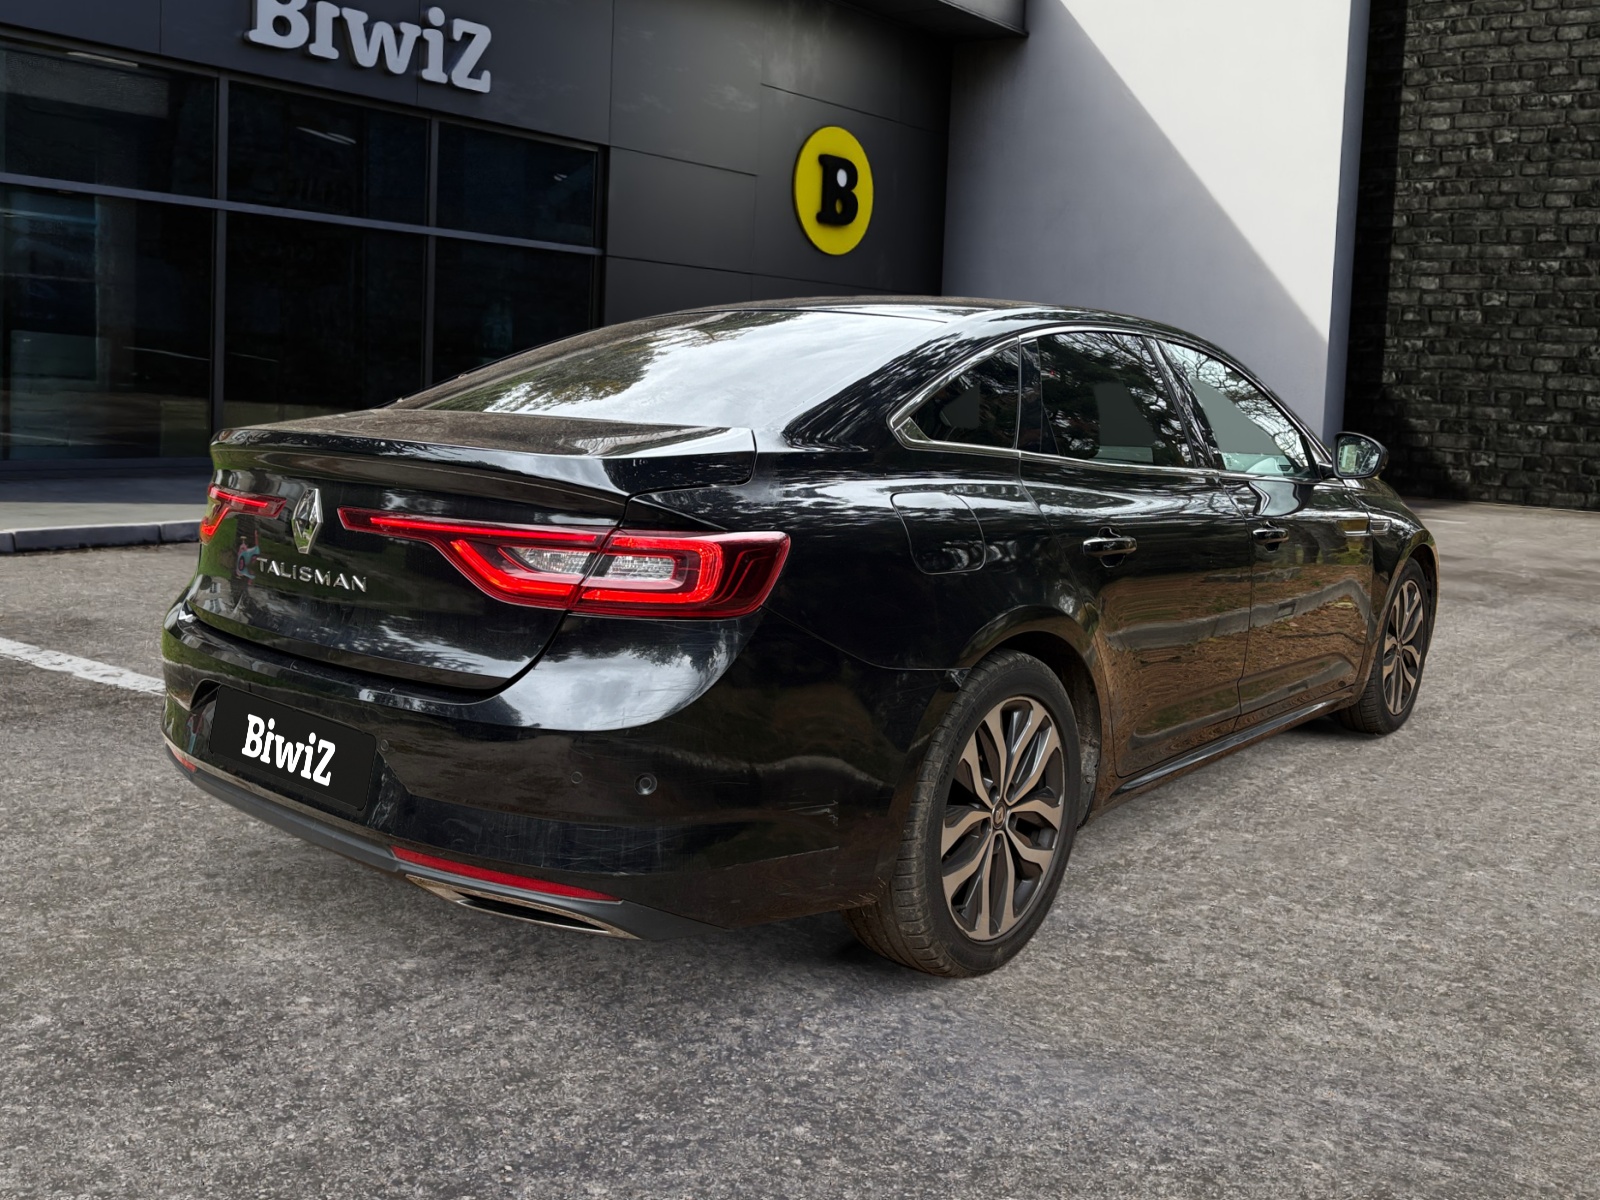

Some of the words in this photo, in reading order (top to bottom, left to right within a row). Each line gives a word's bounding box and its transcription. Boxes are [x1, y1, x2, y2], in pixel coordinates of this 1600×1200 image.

[816, 154, 859, 226] B
[256, 557, 367, 593] TALISMAN
[242, 714, 336, 786] BiwiZ
